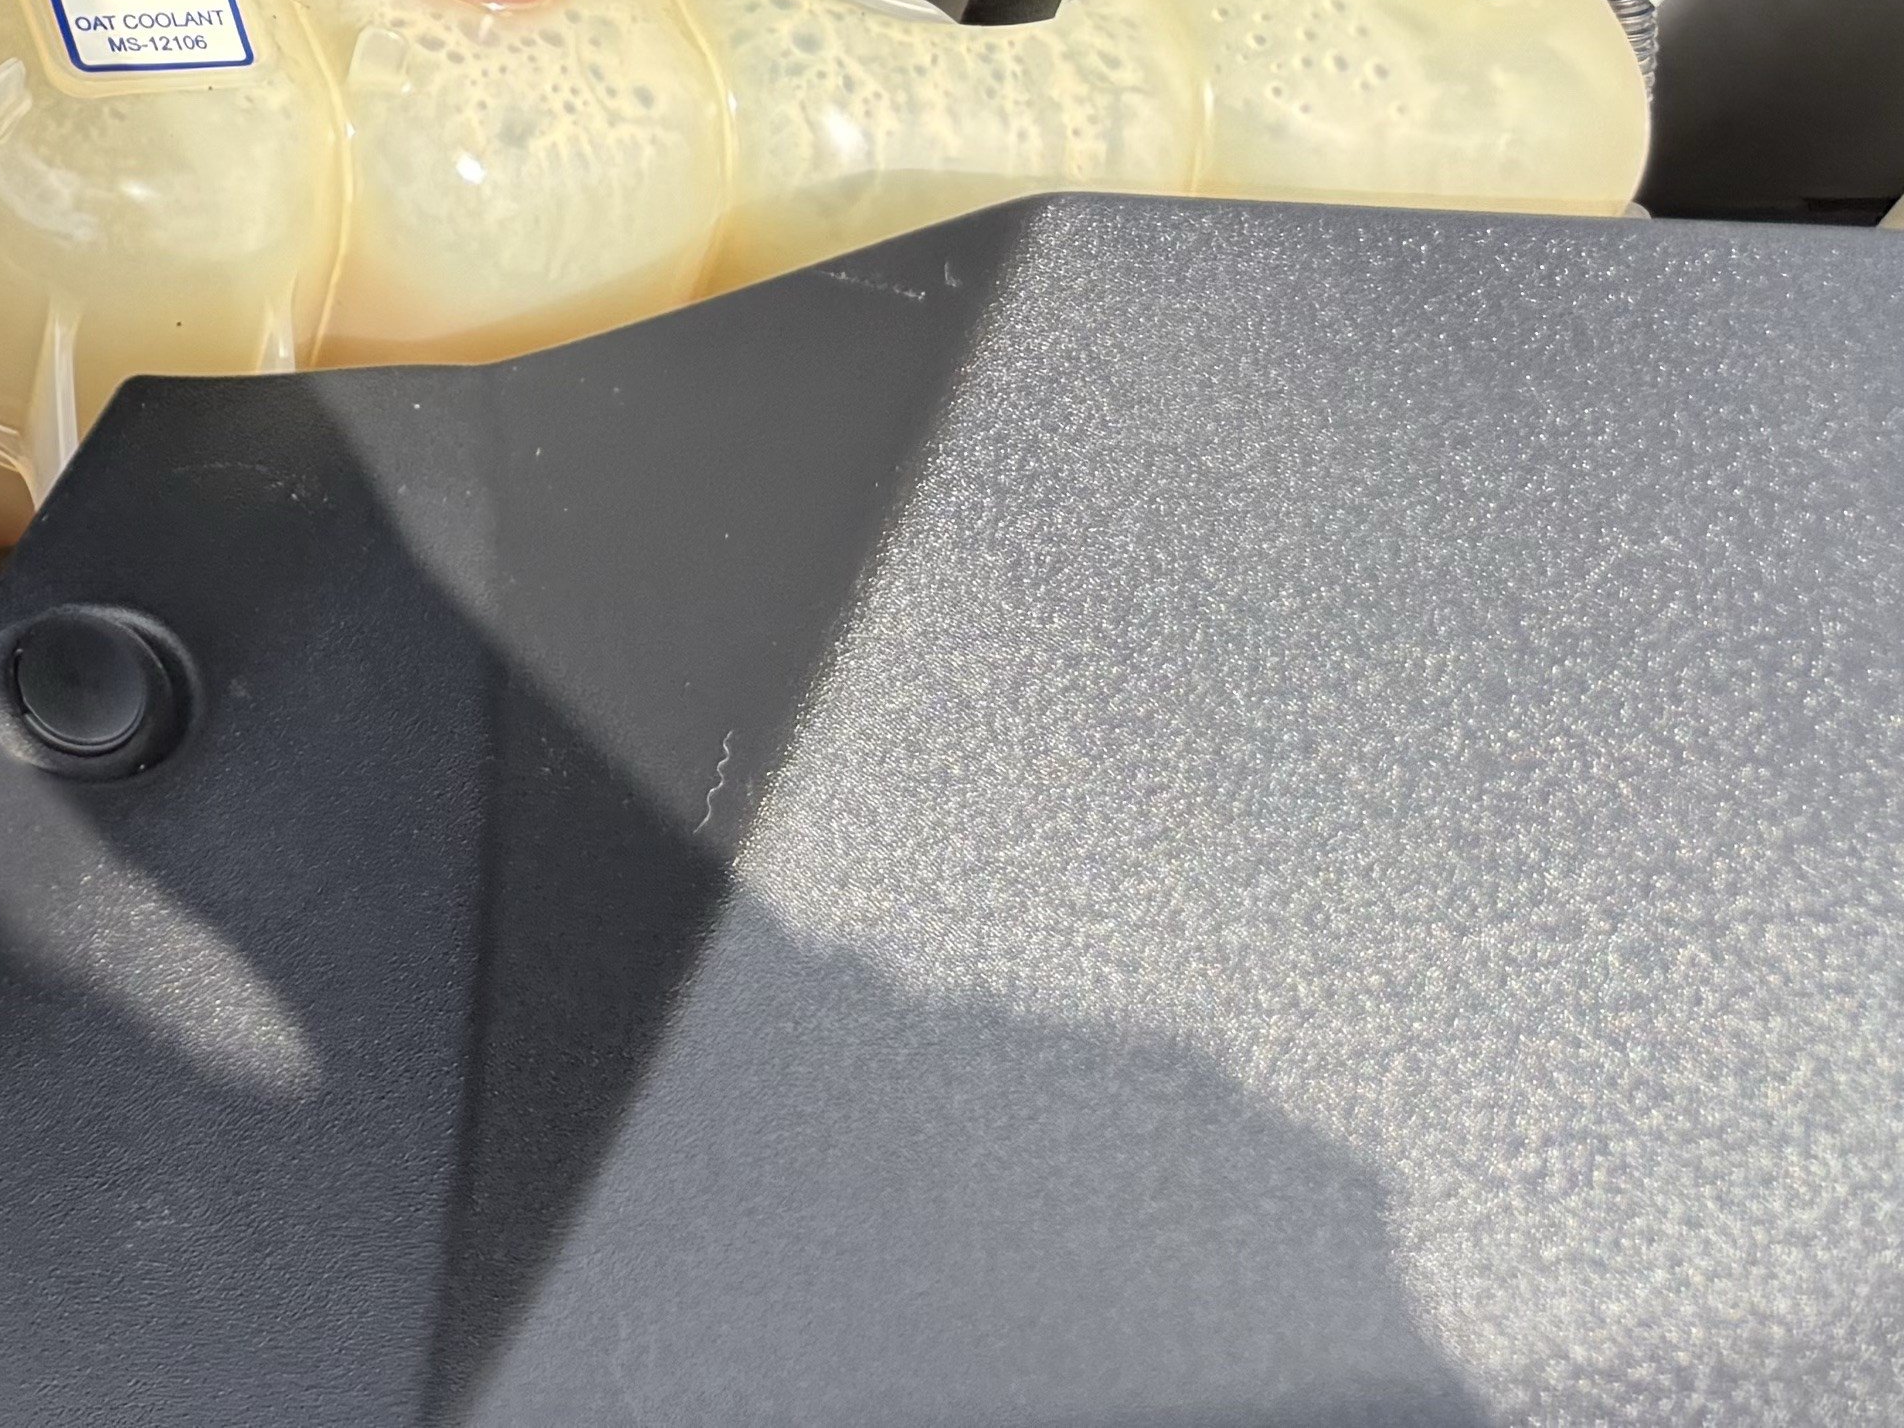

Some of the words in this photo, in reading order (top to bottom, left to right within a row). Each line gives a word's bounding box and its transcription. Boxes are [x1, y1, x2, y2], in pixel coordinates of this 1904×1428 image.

[75, 15, 116, 32] OAT
[123, 9, 225, 31] COOLANT
[108, 35, 208, 53] MS-12106
